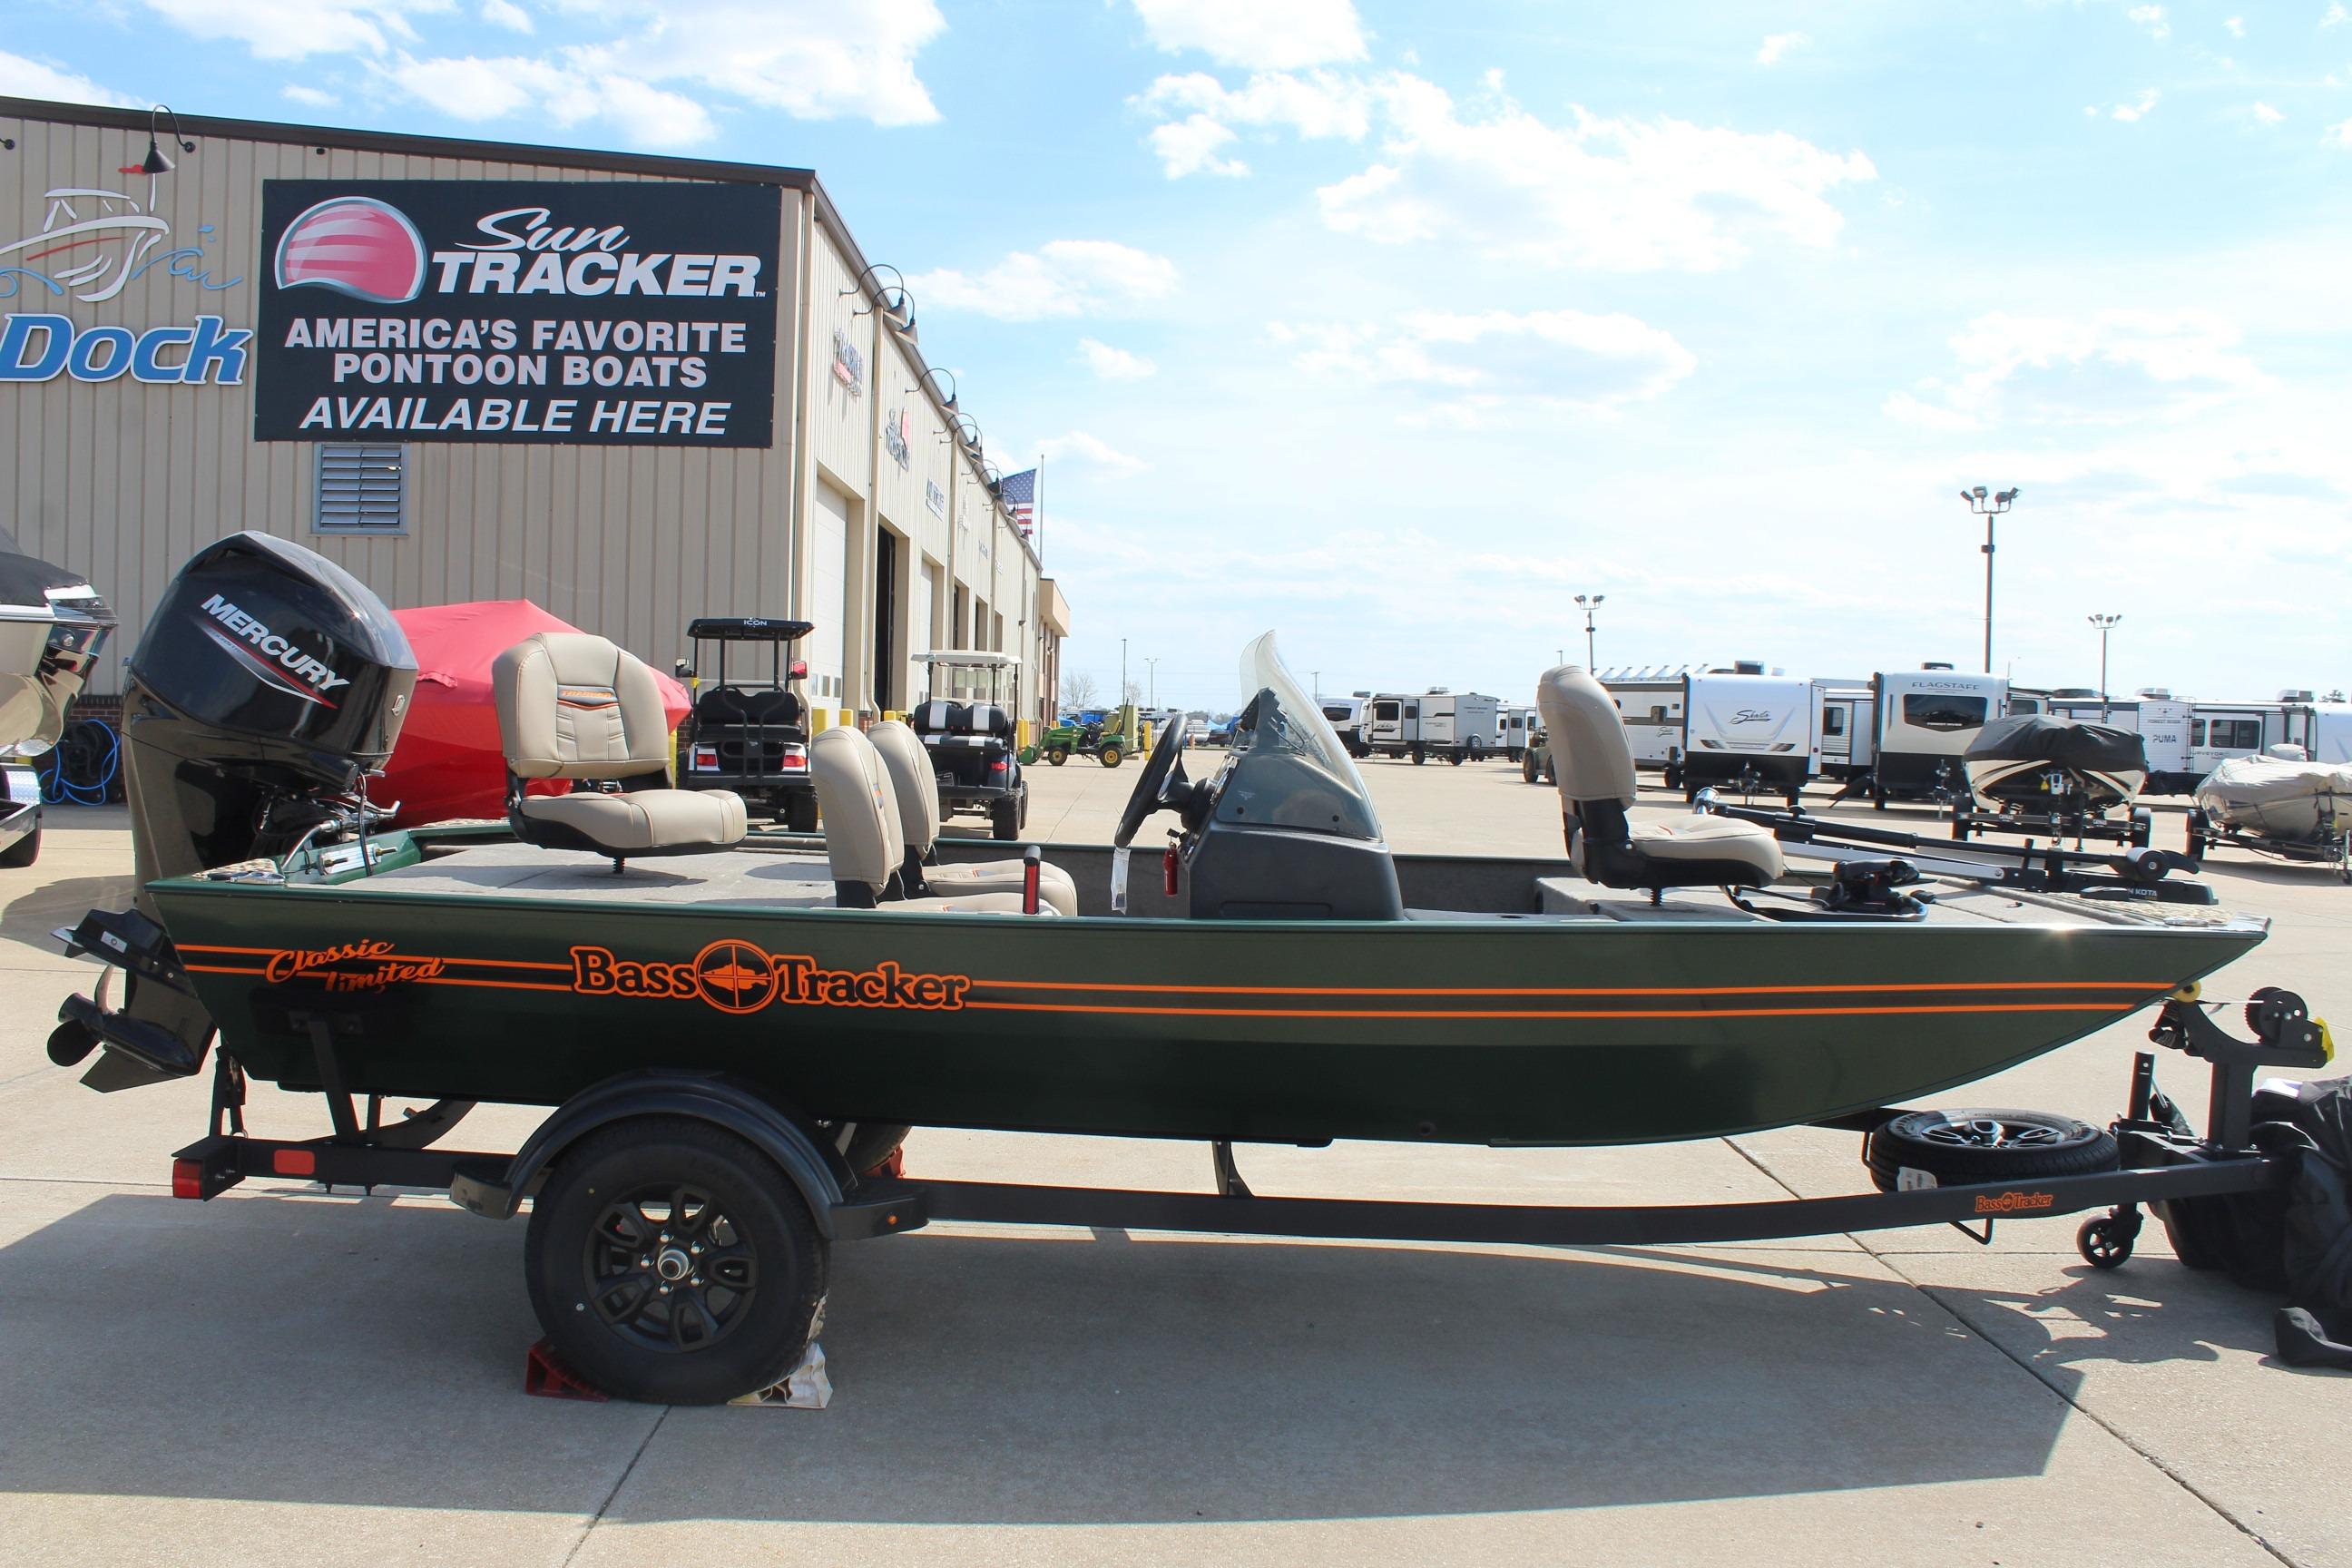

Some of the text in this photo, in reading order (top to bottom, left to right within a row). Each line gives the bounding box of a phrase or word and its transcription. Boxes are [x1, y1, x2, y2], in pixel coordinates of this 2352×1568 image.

[455, 207, 630, 252] Sun
[432, 251, 762, 298] TRACKER
[0, 313, 254, 385] Dock
[284, 318, 747, 353] AMERICA'S FAVORITE
[333, 352, 707, 388] PONTOON BOATS
[299, 397, 731, 436] AVAILABLE HERE
[201, 593, 350, 691] MERCURY
[1912, 681, 1980, 691] FLAGSTAFF
[2152, 734, 2177, 744] PUMA
[2135, 887, 2158, 897] KOTA
[266, 938, 395, 984] Classic
[570, 946, 971, 1010] Bass Tracker
[1975, 1192, 2053, 1212] Bass Tracker
